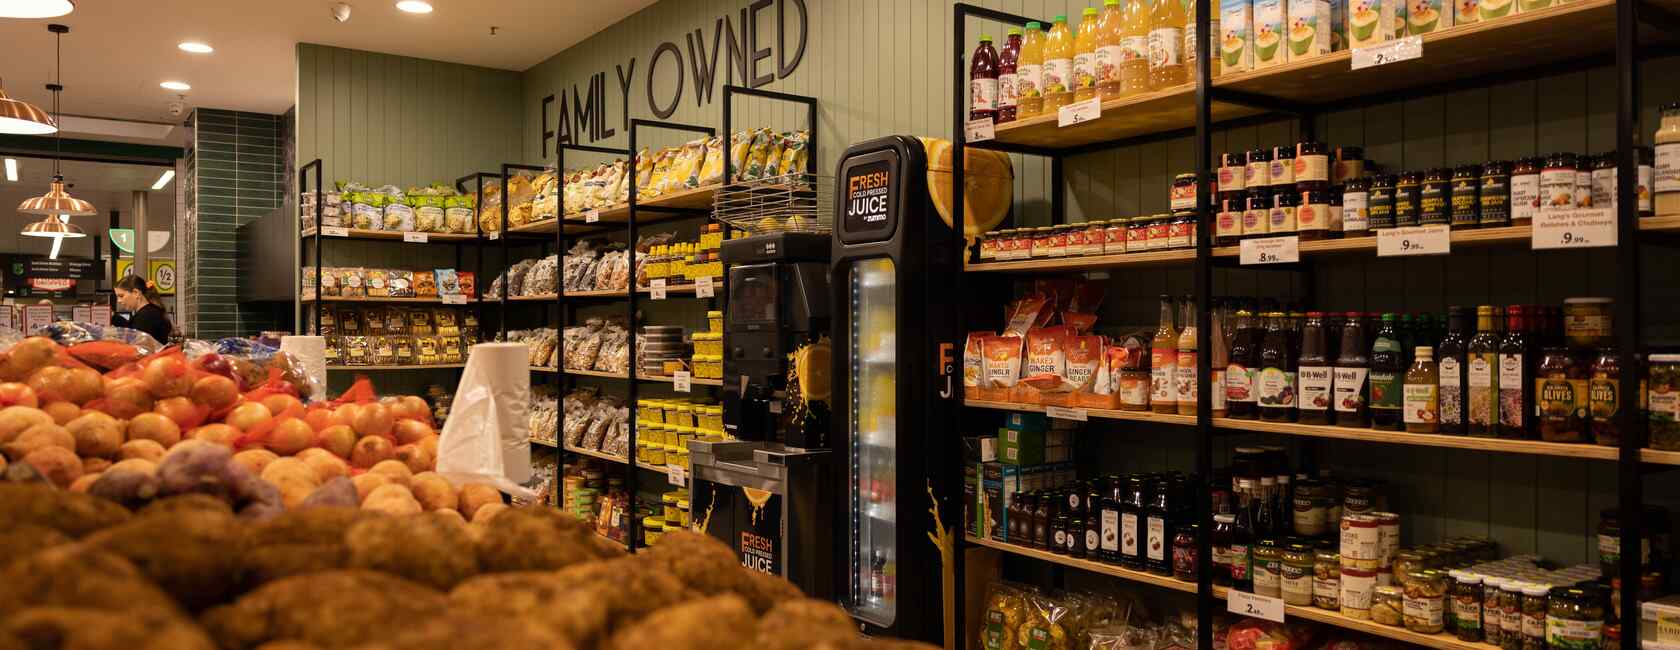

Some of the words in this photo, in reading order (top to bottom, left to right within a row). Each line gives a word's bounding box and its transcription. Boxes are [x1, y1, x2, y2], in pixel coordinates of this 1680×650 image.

[542, 57, 636, 159] FAMILY
[646, 0, 808, 119] OWNED
[850, 171, 889, 200] FRESH
[848, 195, 887, 216] JUICE
[1548, 212, 1571, 220] Lang's
[1573, 210, 1604, 219] Gourmet
[120, 232, 127, 243] 1
[159, 269, 172, 281] 1/2
[1029, 364, 1056, 373] GINGER
[741, 531, 773, 553] FRESH
[742, 553, 773, 575] JUICE
